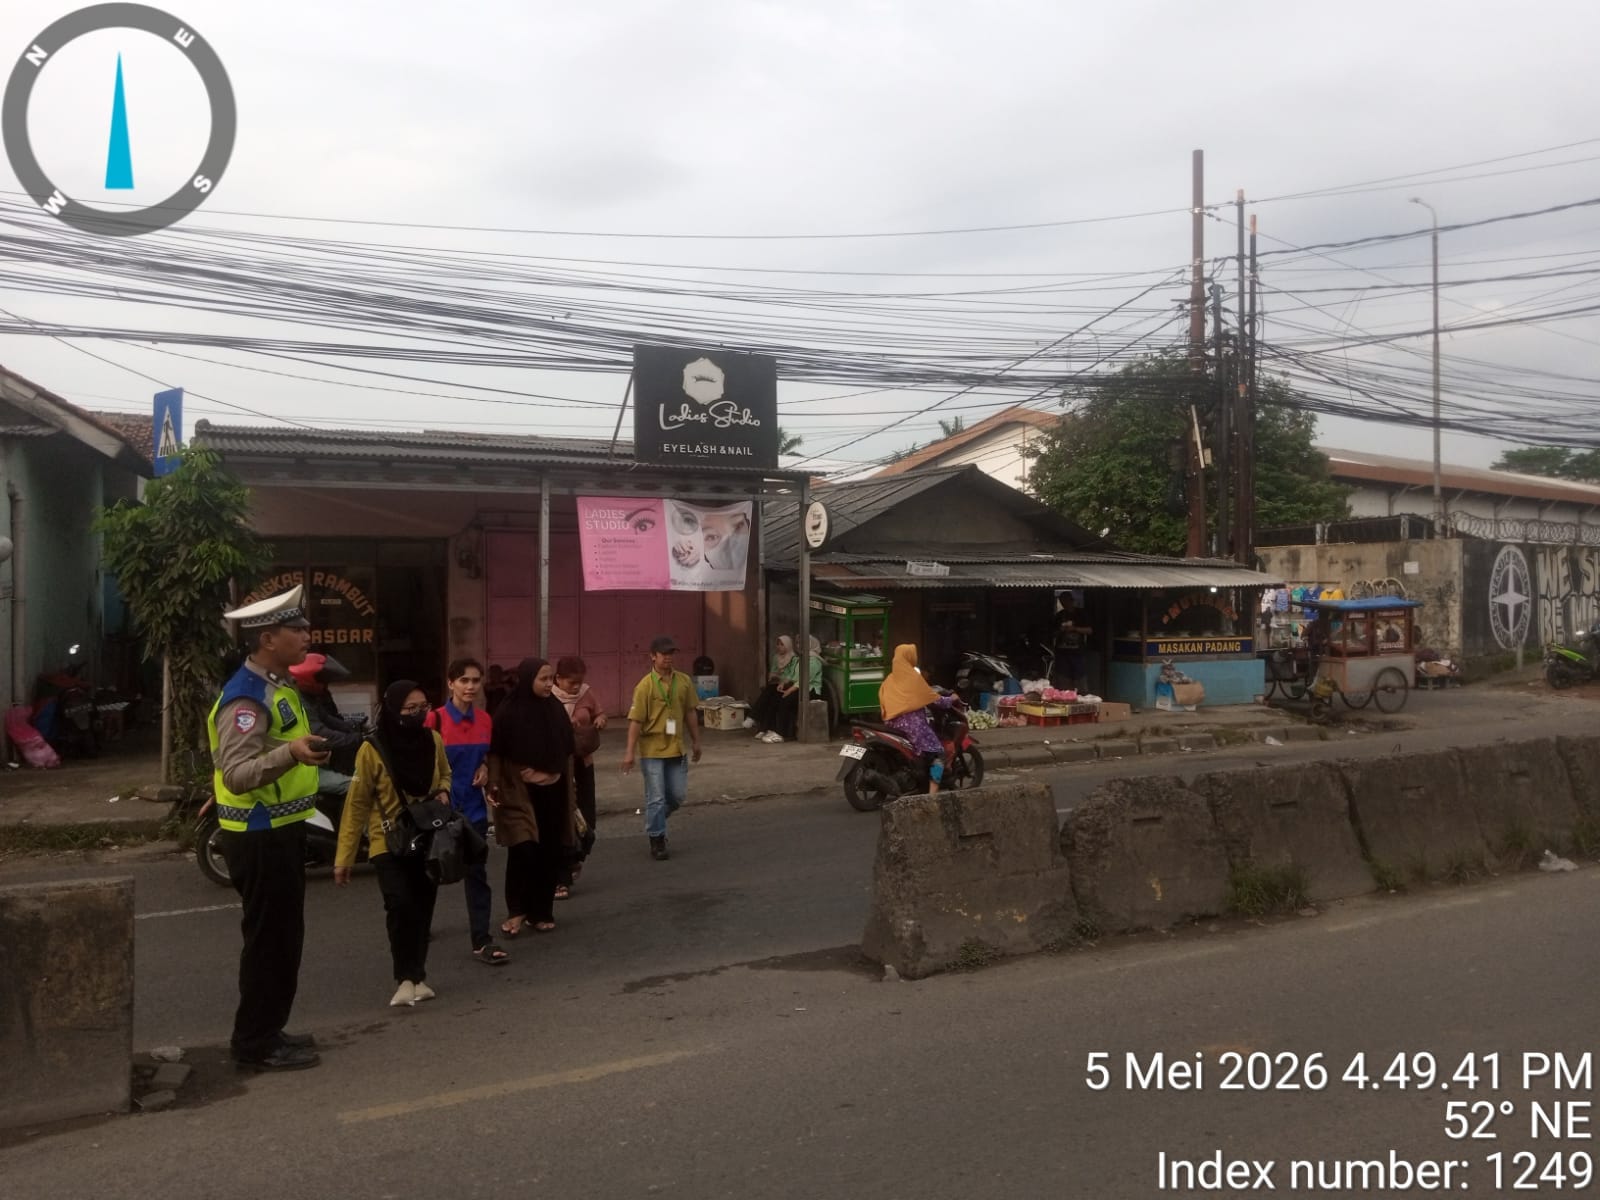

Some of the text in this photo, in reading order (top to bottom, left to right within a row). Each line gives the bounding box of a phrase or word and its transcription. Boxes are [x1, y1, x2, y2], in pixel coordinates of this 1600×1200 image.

[659, 400, 760, 430] Ladies Studio
[663, 443, 717, 454] EYELASH
[727, 446, 753, 456] NAIL
[584, 508, 626, 519] LADIES
[585, 519, 630, 530] STUDIO
[1537, 546, 1571, 600] WE
[240, 570, 376, 617] ANGKAS RAMBUT
[1158, 641, 1241, 654] MASAKAN PADANG
